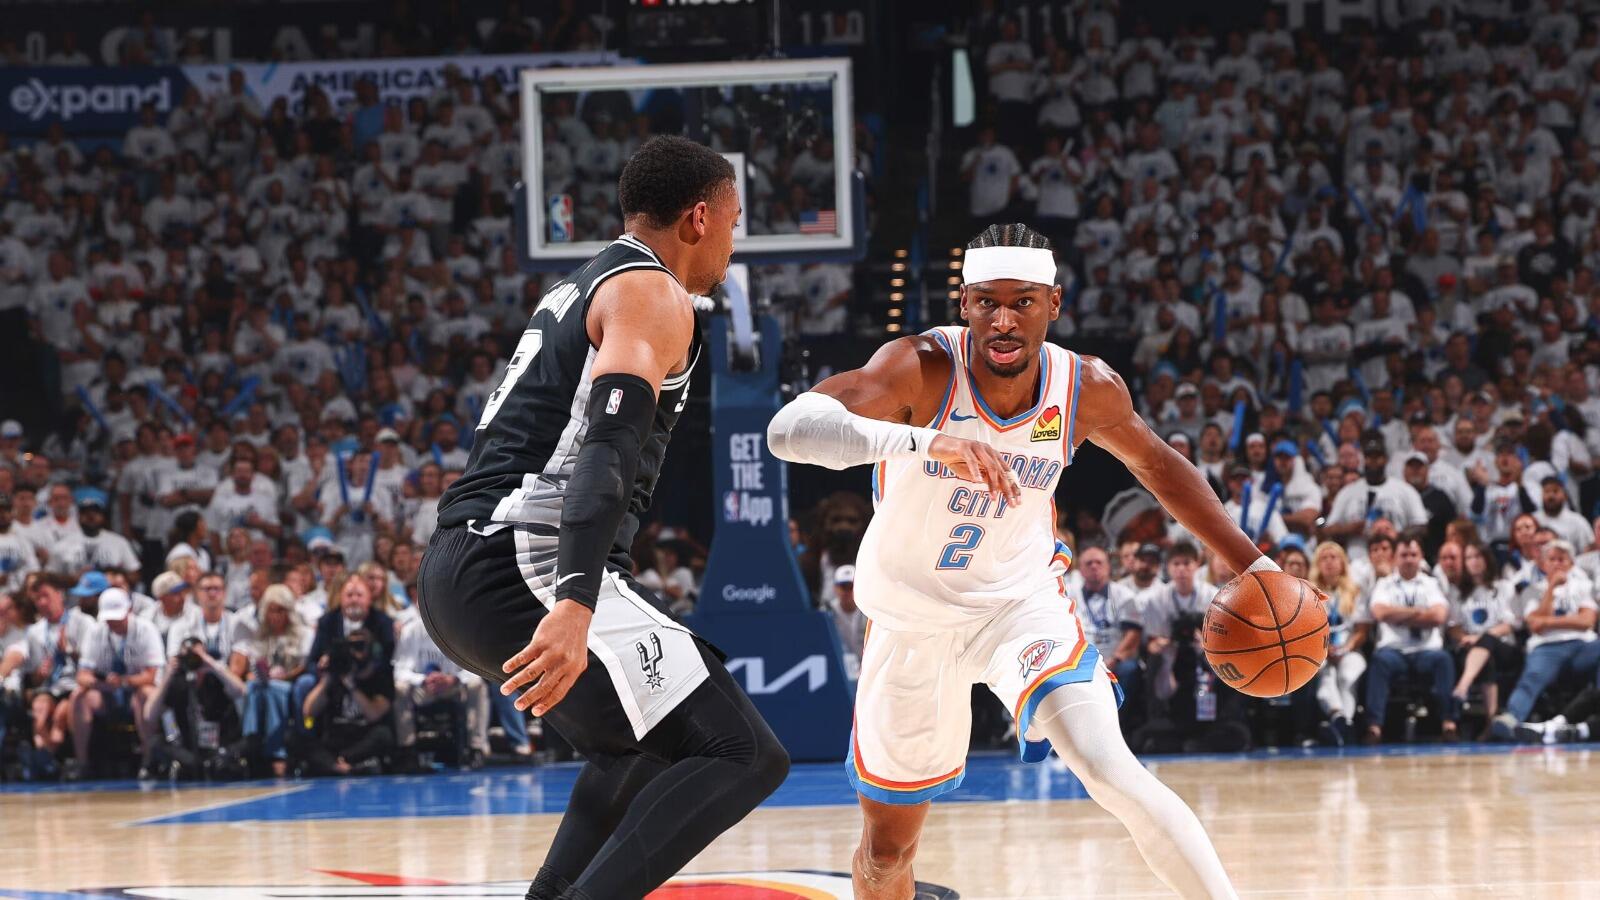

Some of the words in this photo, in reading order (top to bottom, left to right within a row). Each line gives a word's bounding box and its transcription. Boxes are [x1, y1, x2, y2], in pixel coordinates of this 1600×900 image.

[9, 77, 171, 121] expand
[730, 433, 763, 461] GET
[731, 463, 764, 489] THE
[740, 491, 773, 526] App
[947, 486, 1009, 518] CITY
[935, 522, 985, 570] 2
[722, 583, 776, 602] Google
